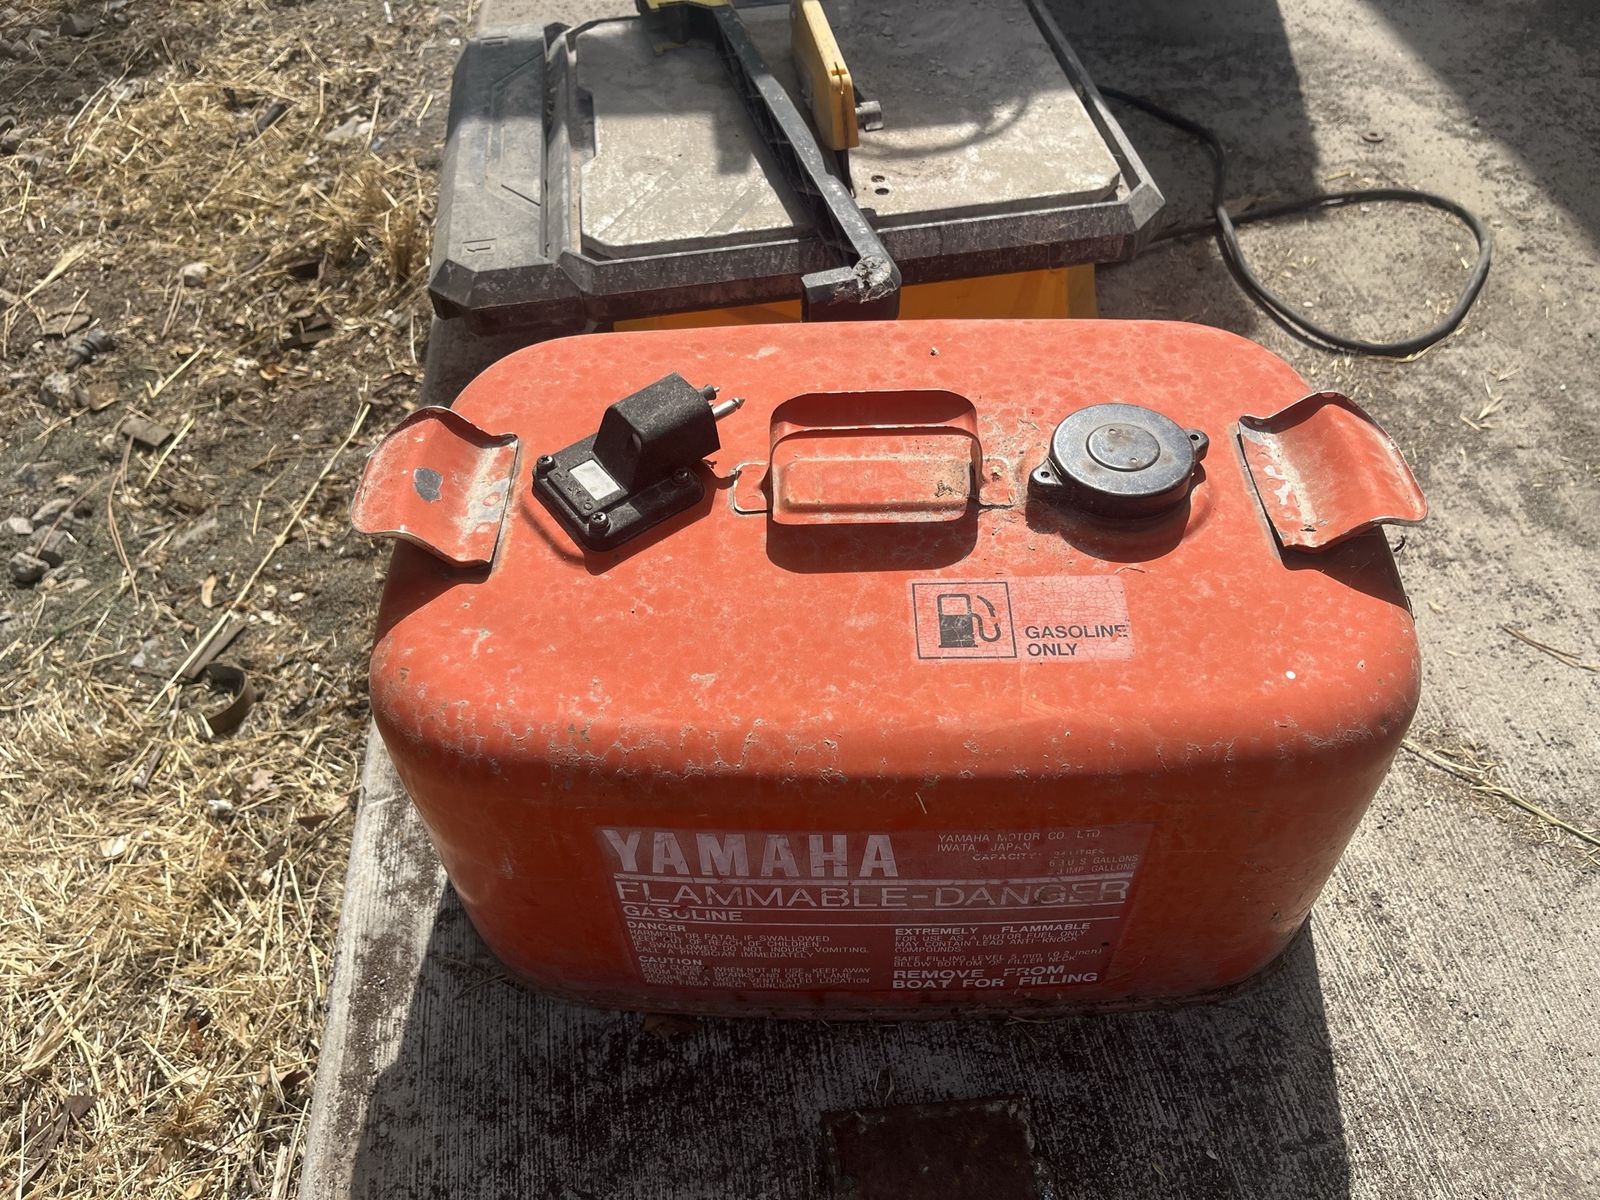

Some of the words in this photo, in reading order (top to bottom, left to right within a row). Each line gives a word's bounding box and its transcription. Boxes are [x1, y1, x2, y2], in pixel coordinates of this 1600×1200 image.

[1025, 624, 1128, 639] GASOLINE
[1027, 642, 1078, 657] ONLY
[938, 834, 990, 842] YAMAHA
[997, 832, 1040, 842] MOTOR
[990, 842, 1031, 852] JAPAN
[602, 829, 899, 877] YAMAHA
[1093, 854, 1138, 865] GALLONS
[1091, 862, 1136, 872] GALLONS
[615, 880, 1130, 908] FLAMMABLE-DANGER
[622, 905, 744, 922] GASOLINE
[626, 921, 686, 932] DANGER
[895, 927, 978, 936] EXTREMELY
[1000, 922, 1092, 933] FLAMMABLE
[629, 929, 677, 938] HARMFUL
[685, 932, 700, 940] OR
[649, 942, 717, 952] SWALLOWED
[924, 940, 972, 948] CONTAIN
[1009, 936, 1078, 945] ANTI-KNOCK
[635, 946, 662, 954] CALL
[679, 949, 735, 958] PHYSICIAN
[638, 955, 703, 966] CAUTION
[893, 960, 932, 968] BELOW
[937, 960, 982, 968] BOTTOM
[1007, 957, 1043, 965] FILLER
[926, 954, 966, 962] FILLING
[893, 969, 985, 979] REMOVE
[1003, 965, 1065, 976] FROM
[892, 979, 952, 989] BOAT
[962, 978, 1005, 988] FOR
[1018, 972, 1098, 986] FILLING
